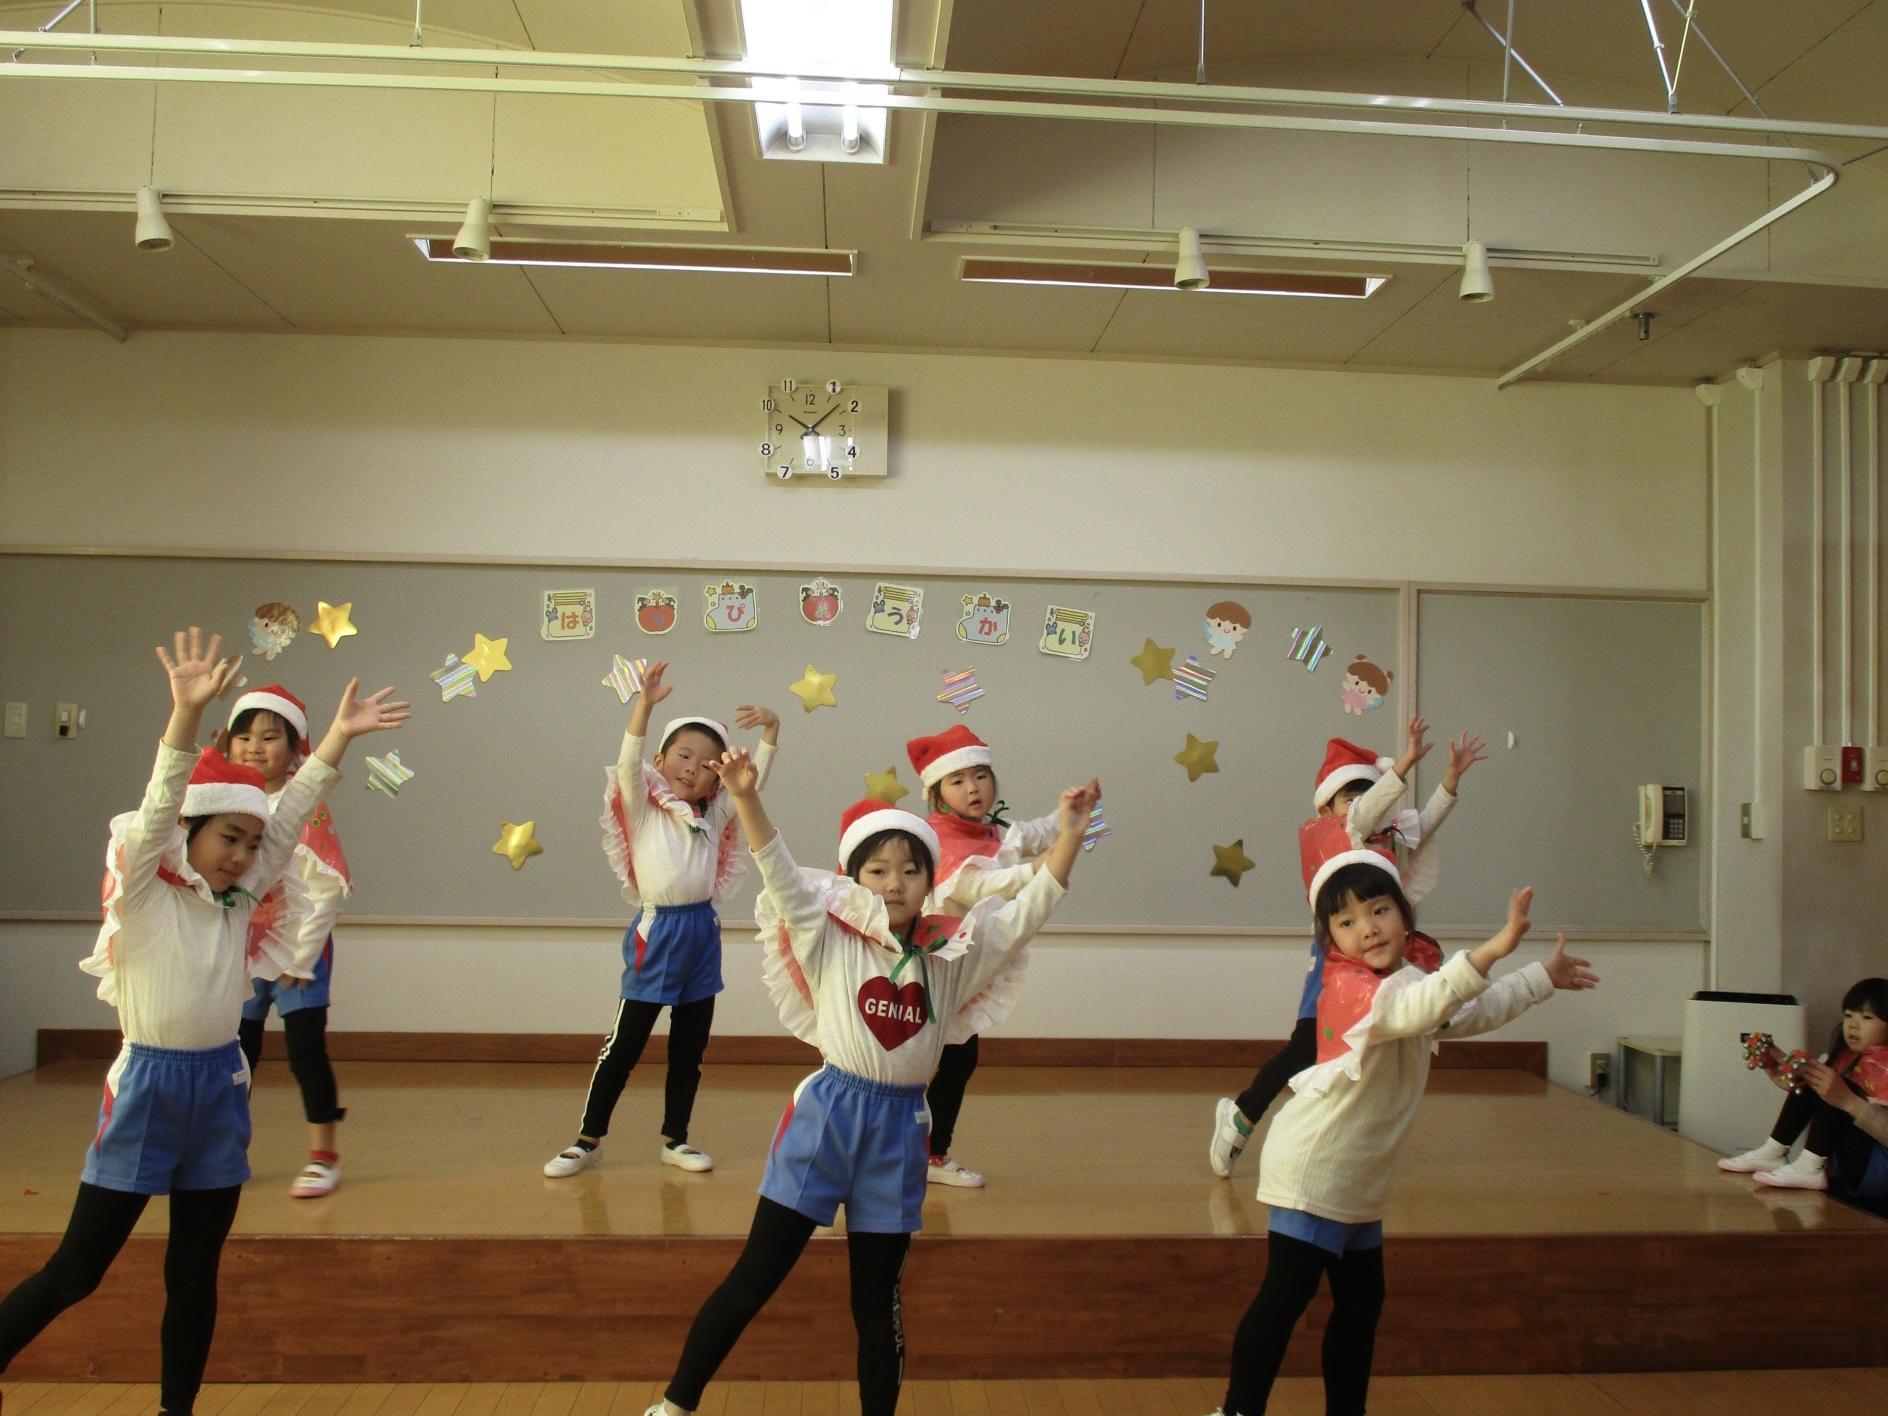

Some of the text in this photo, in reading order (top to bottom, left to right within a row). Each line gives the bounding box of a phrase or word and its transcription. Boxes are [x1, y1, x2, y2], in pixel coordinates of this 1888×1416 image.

[784, 379, 793, 392] 11
[830, 381, 837, 393] 1
[762, 400, 773, 412] 10
[805, 394, 816, 406] 12
[850, 400, 859, 413] 2
[775, 424, 783, 435] 9
[838, 425, 846, 437] 3
[761, 443, 771, 456] 8
[848, 446, 857, 458] 4
[780, 466, 789, 478] 7
[830, 467, 839, 479] 5
[561, 612, 580, 631] は
[887, 606, 904, 626] う
[978, 617, 998, 636] か
[1058, 628, 1077, 646] い
[864, 998, 922, 1024] GENIAL
